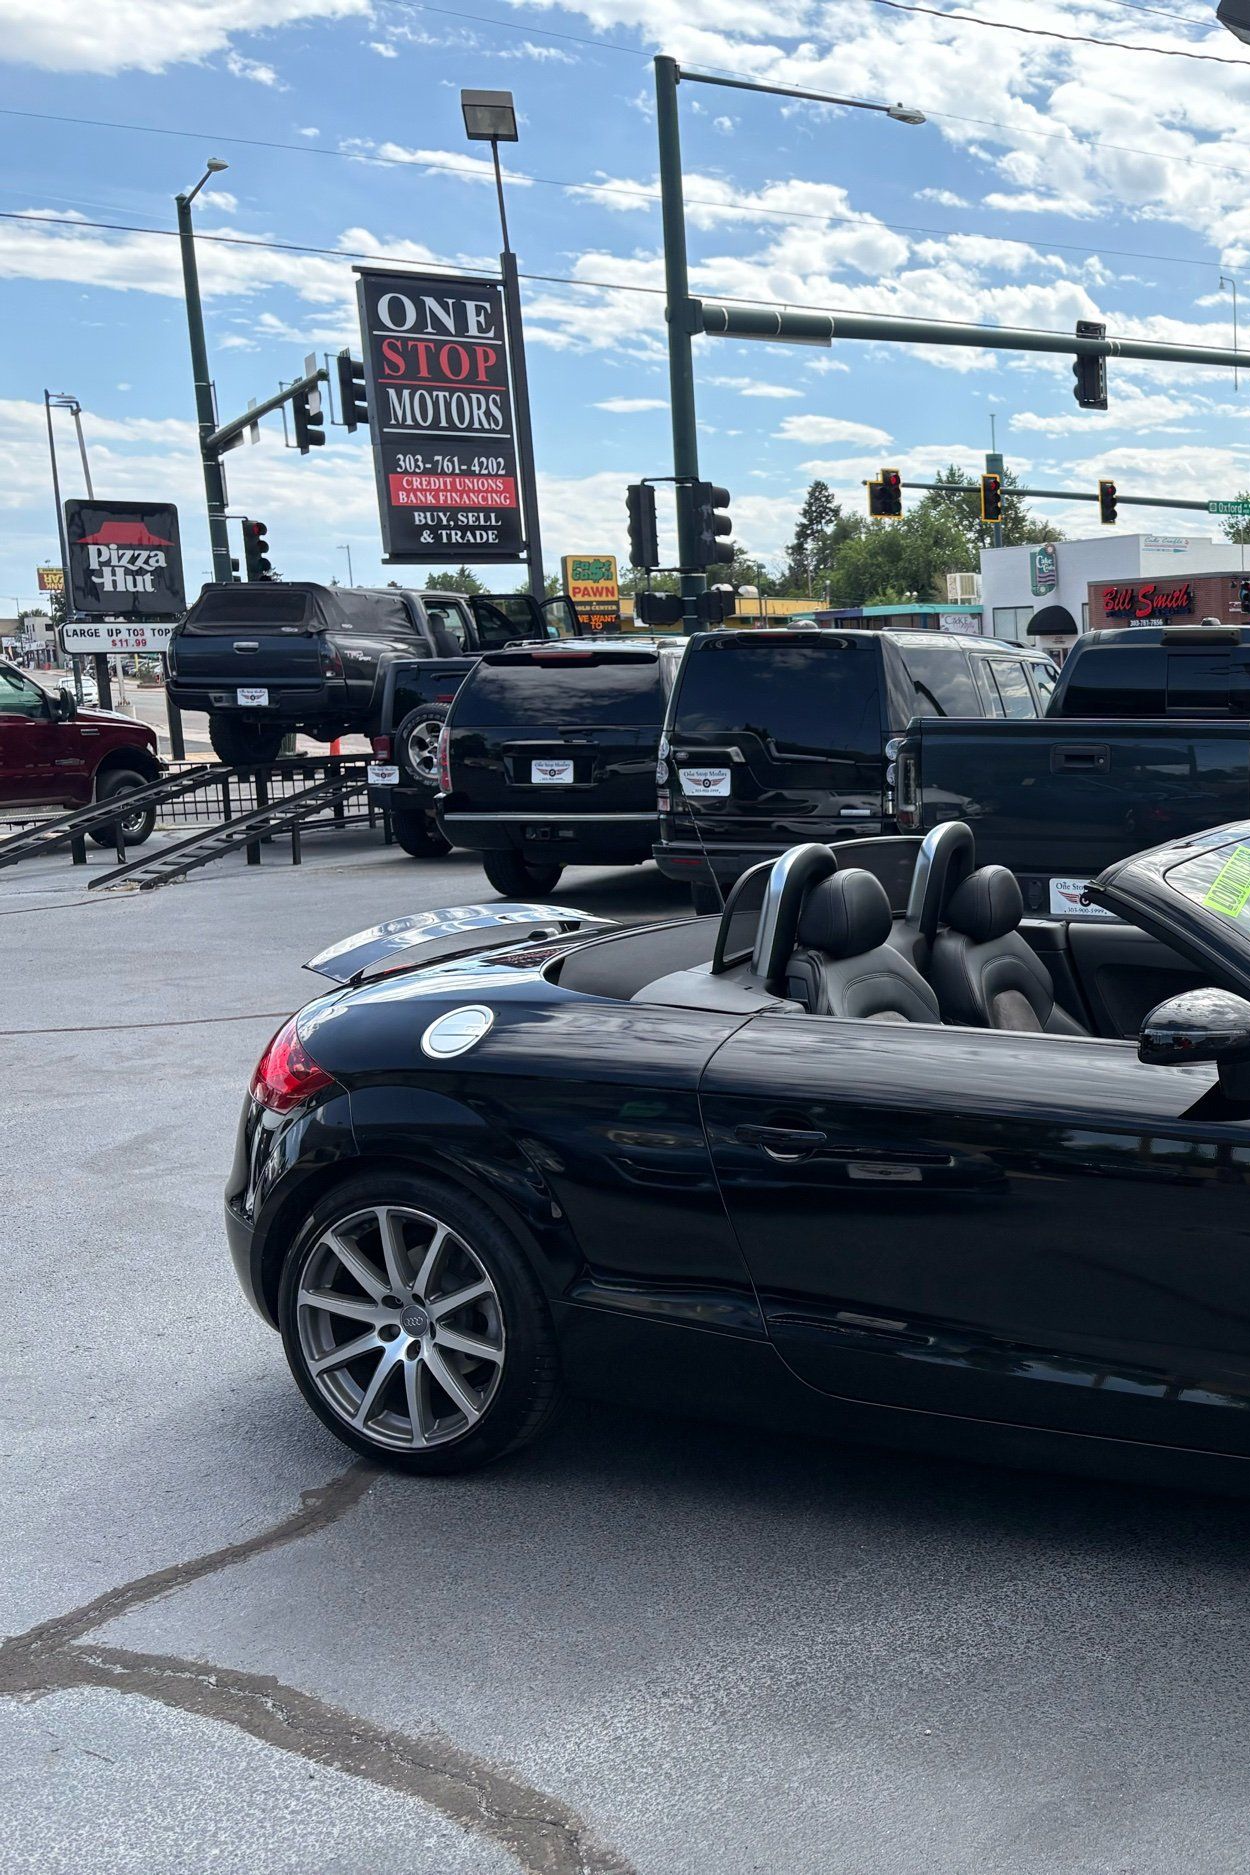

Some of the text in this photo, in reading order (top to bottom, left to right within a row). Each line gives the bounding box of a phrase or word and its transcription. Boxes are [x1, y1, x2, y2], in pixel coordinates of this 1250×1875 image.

[378, 293, 495, 338] ONE
[382, 338, 497, 382] STOP
[386, 388, 503, 430] MOTORS
[402, 477, 504, 490] CREDIT UNIONS
[400, 491, 510, 505] BANK FINANCING
[1218, 502, 1242, 514] Oxford
[414, 512, 501, 527] BUY, SELL
[420, 530, 498, 544] & TRADE
[88, 544, 167, 570] Pizza
[92, 566, 155, 592] Hut
[572, 586, 615, 598] PAWN
[1103, 584, 1190, 618] Bill Smith
[591, 614, 616, 622] WANT
[66, 629, 100, 637] LARGE
[107, 629, 121, 637] UP
[591, 622, 602, 630] TO
[112, 639, 146, 647] $11.99
[1056, 882, 1070, 890] One
[1207, 878, 1242, 911] LOW
